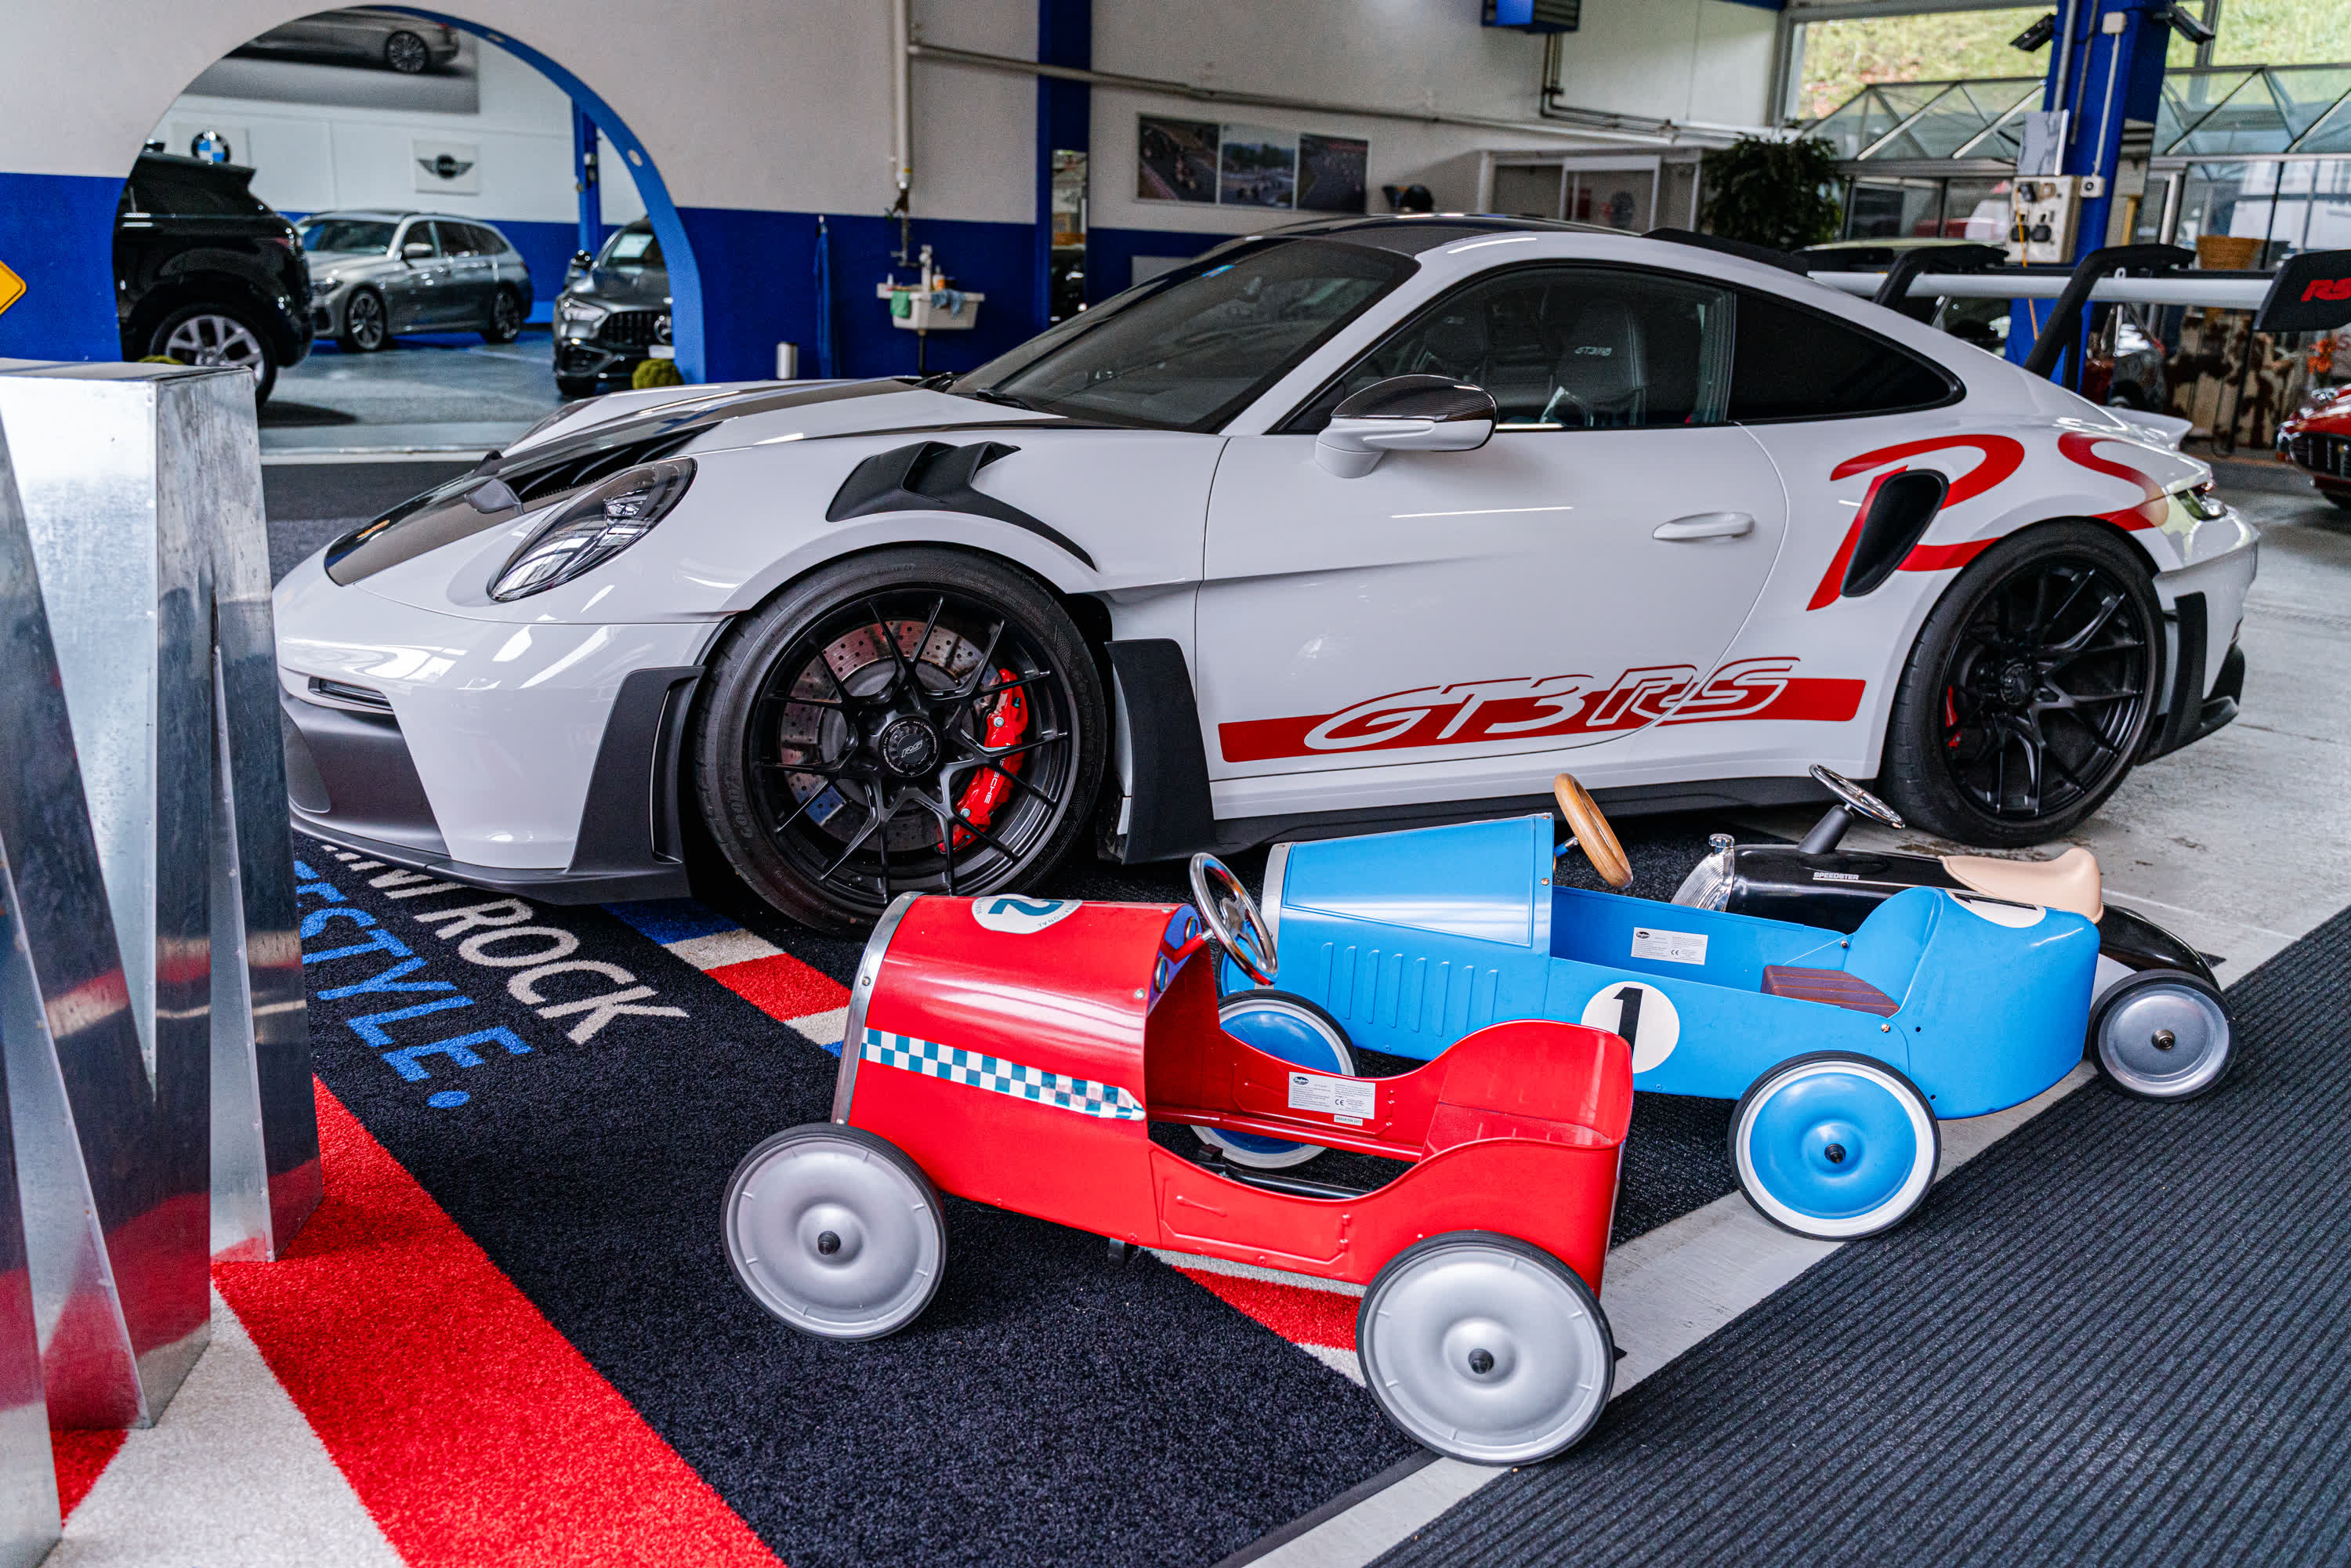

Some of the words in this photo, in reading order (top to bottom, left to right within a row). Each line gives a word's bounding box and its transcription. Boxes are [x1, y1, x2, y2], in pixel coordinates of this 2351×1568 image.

[1813, 871, 1860, 881] SPEEDSTER
[987, 898, 1065, 917] 2
[413, 898, 690, 1045] ROCK
[1613, 987, 1643, 1060] 1
